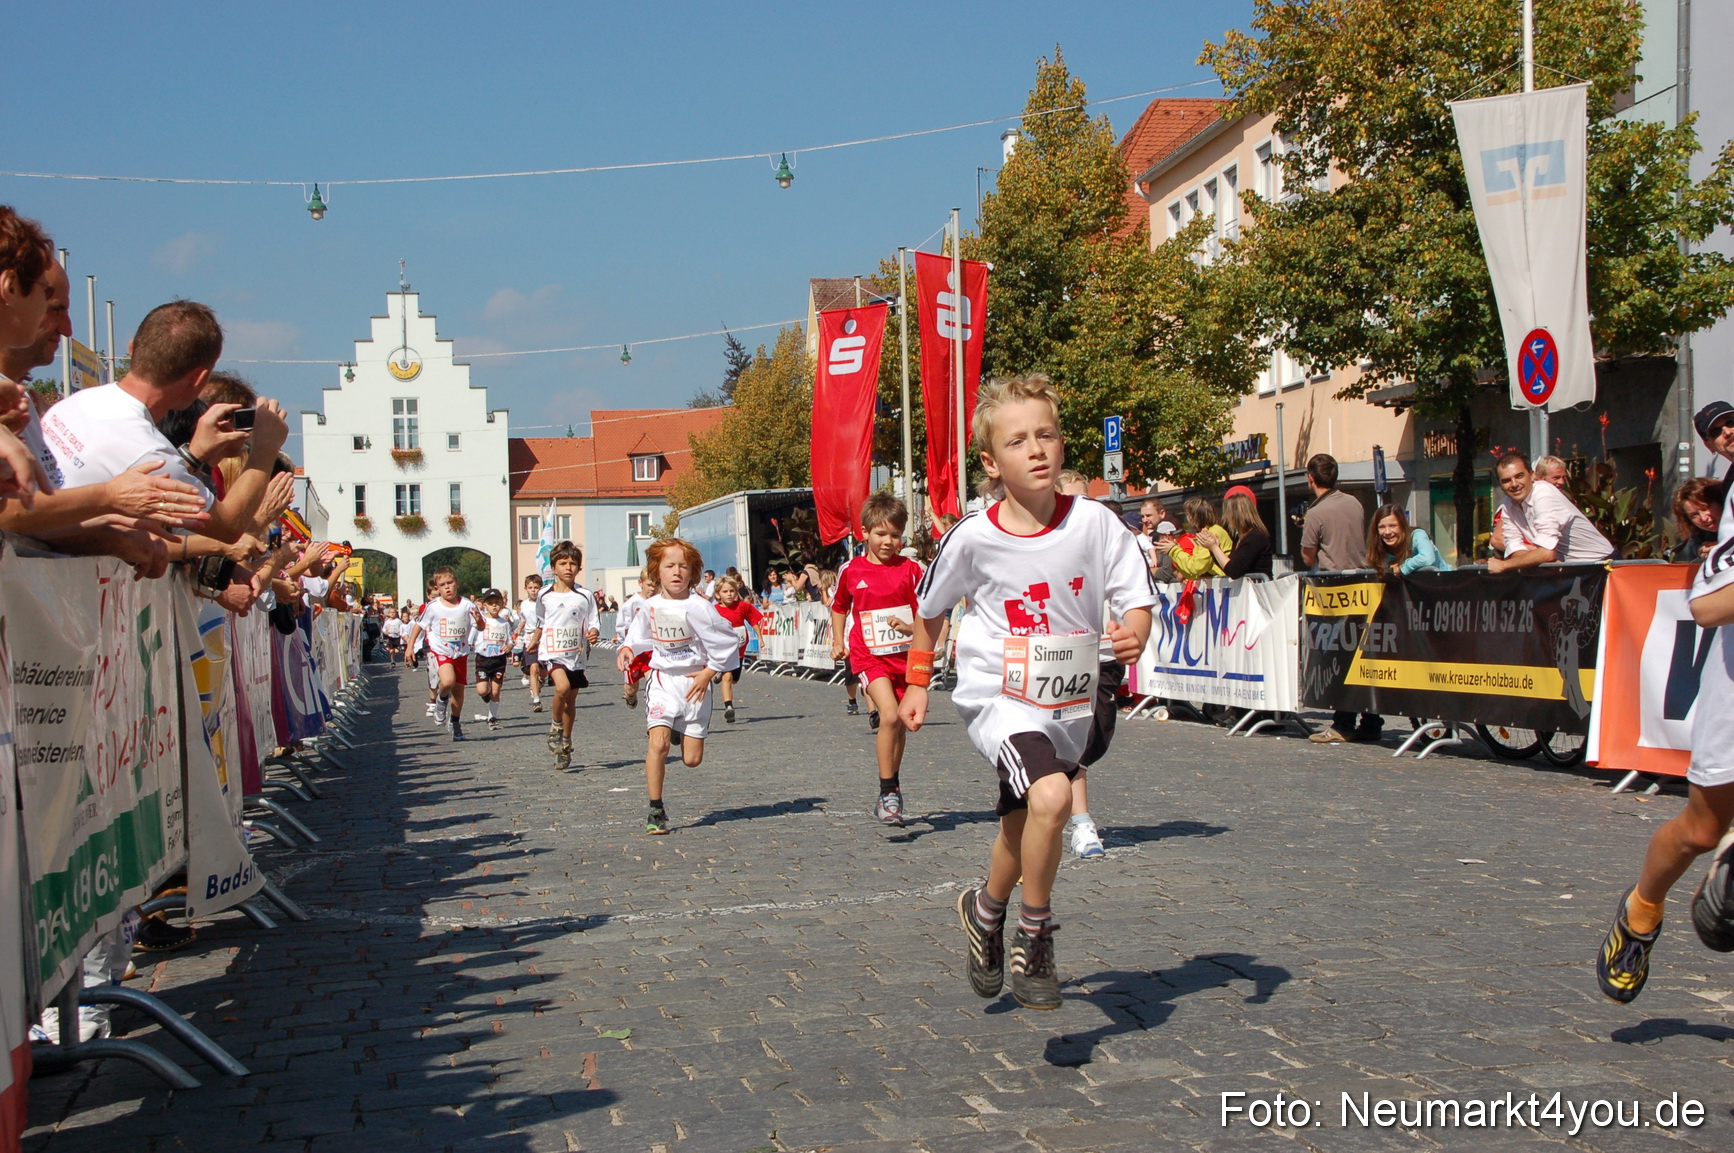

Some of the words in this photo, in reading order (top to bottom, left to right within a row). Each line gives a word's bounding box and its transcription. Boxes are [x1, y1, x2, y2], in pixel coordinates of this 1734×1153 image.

[1108, 421, 1117, 447] P
[1305, 589, 1370, 609] HOLZBAU
[1406, 601, 1430, 631] Tel.:
[1433, 600, 1471, 632] 09181
[1481, 600, 1497, 632] 90
[1500, 600, 1515, 632] 52
[1517, 600, 1534, 632] 26
[556, 628, 579, 639] PAUL
[658, 626, 685, 638] 7171
[1307, 622, 1398, 653] KREUZER
[556, 638, 578, 649] 7296
[1034, 645, 1073, 662] Simon
[1008, 670, 1022, 682] K2
[1036, 673, 1091, 699] 7042
[1359, 664, 1397, 681] Neumarkt
[1428, 671, 1534, 690] www.kreuzer-holzbau.de
